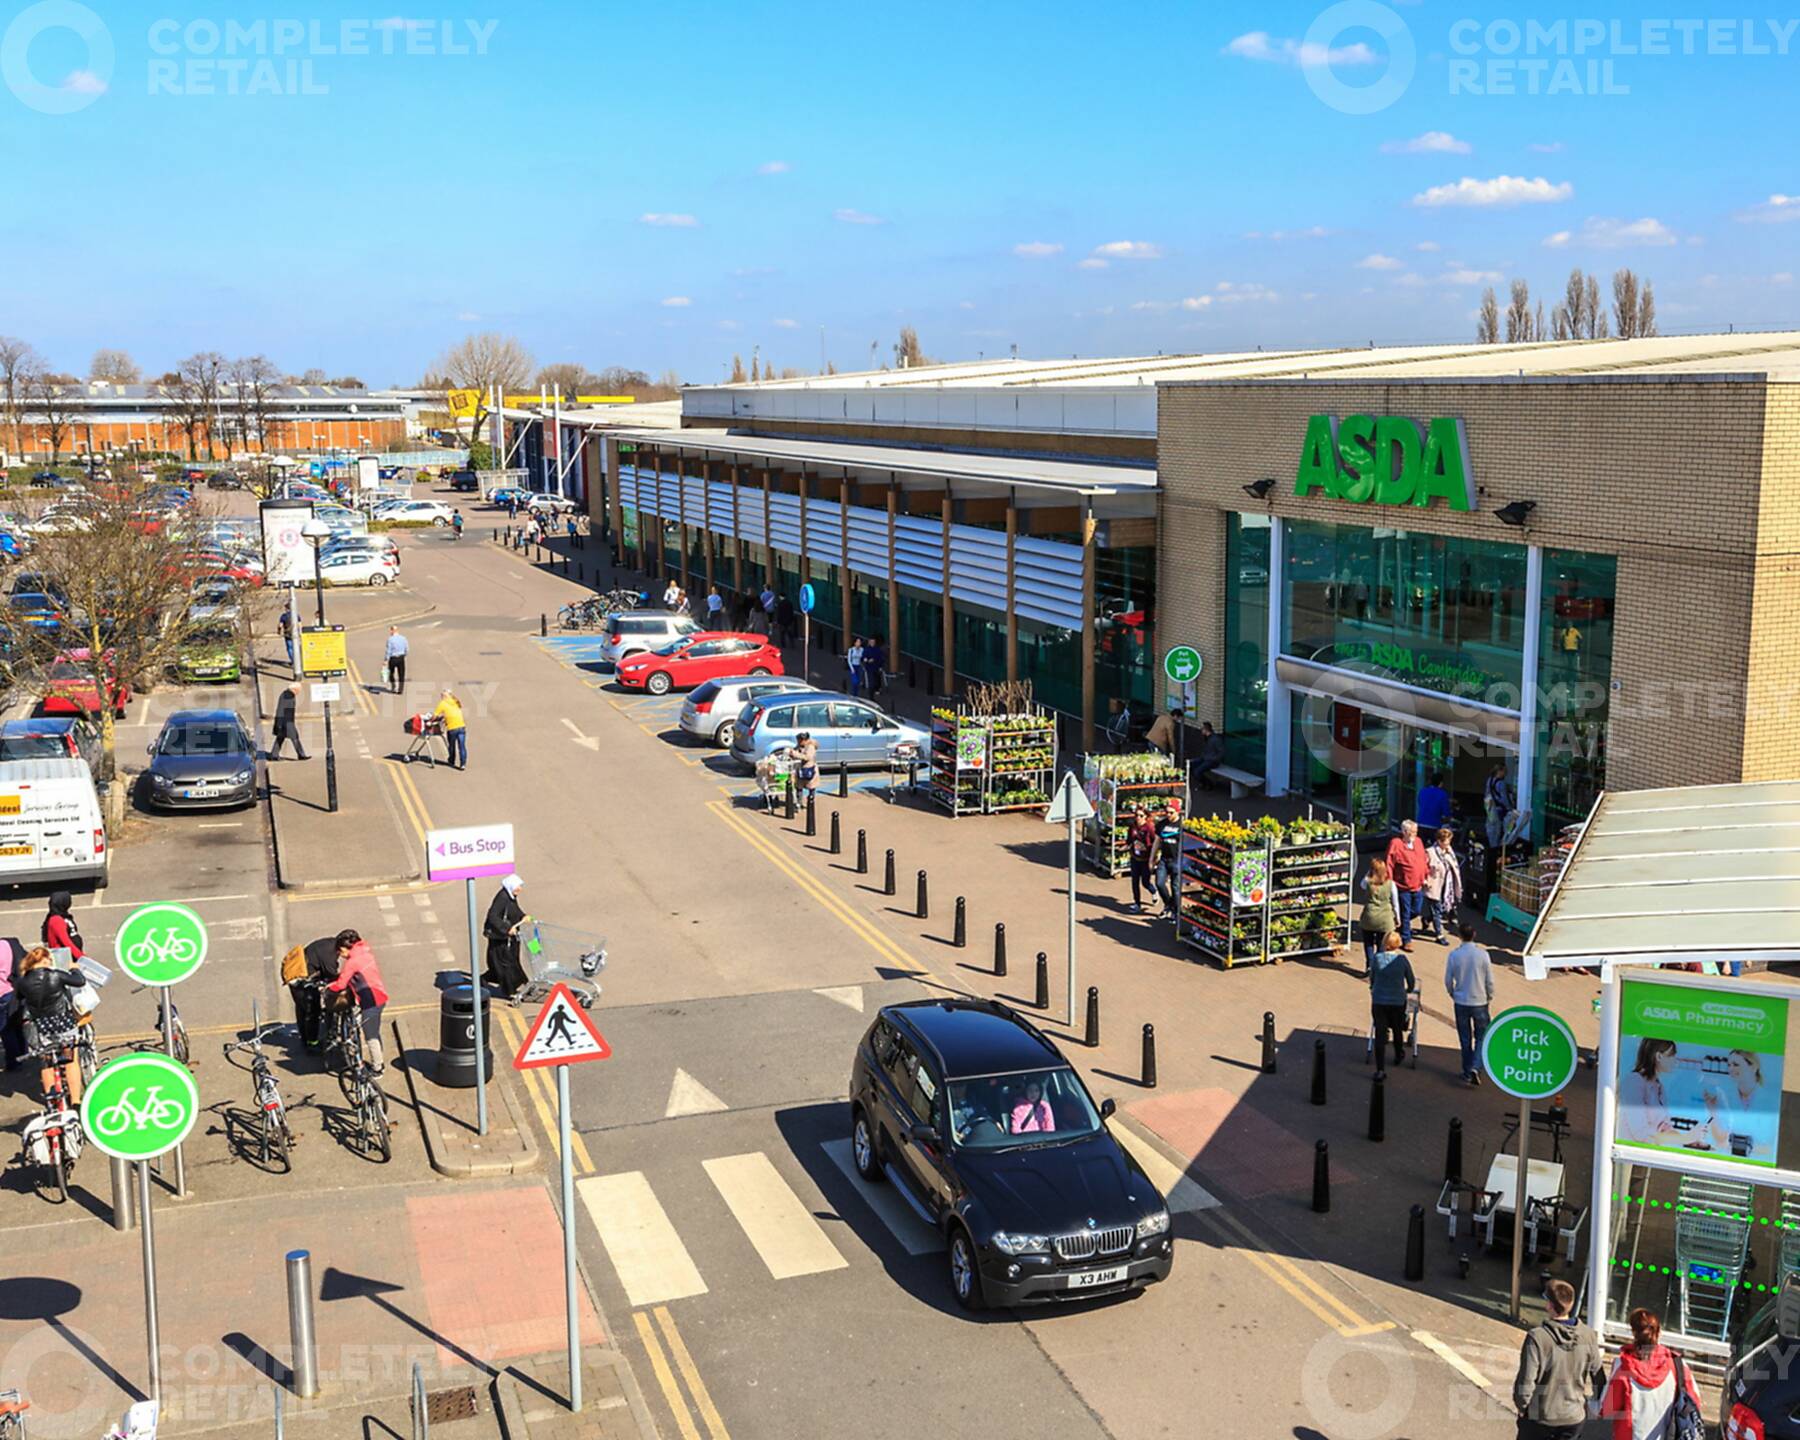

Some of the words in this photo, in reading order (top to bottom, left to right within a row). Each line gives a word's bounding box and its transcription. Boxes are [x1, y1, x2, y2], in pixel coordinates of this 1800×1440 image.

[1293, 413, 1477, 511] ASDA
[1372, 640, 1414, 672] ASDA
[1417, 653, 1485, 686] Cambridge
[449, 842, 474, 855] Bus
[476, 839, 506, 853] Stop
[1642, 1006, 1681, 1022] ASDA
[1685, 1011, 1765, 1034] Pharmacy
[1512, 1028, 1550, 1047] Pick
[1517, 1048, 1542, 1064] up
[1503, 1065, 1553, 1085] Point
[1080, 1273, 1095, 1285] X3
[1096, 1269, 1118, 1283] AHW
